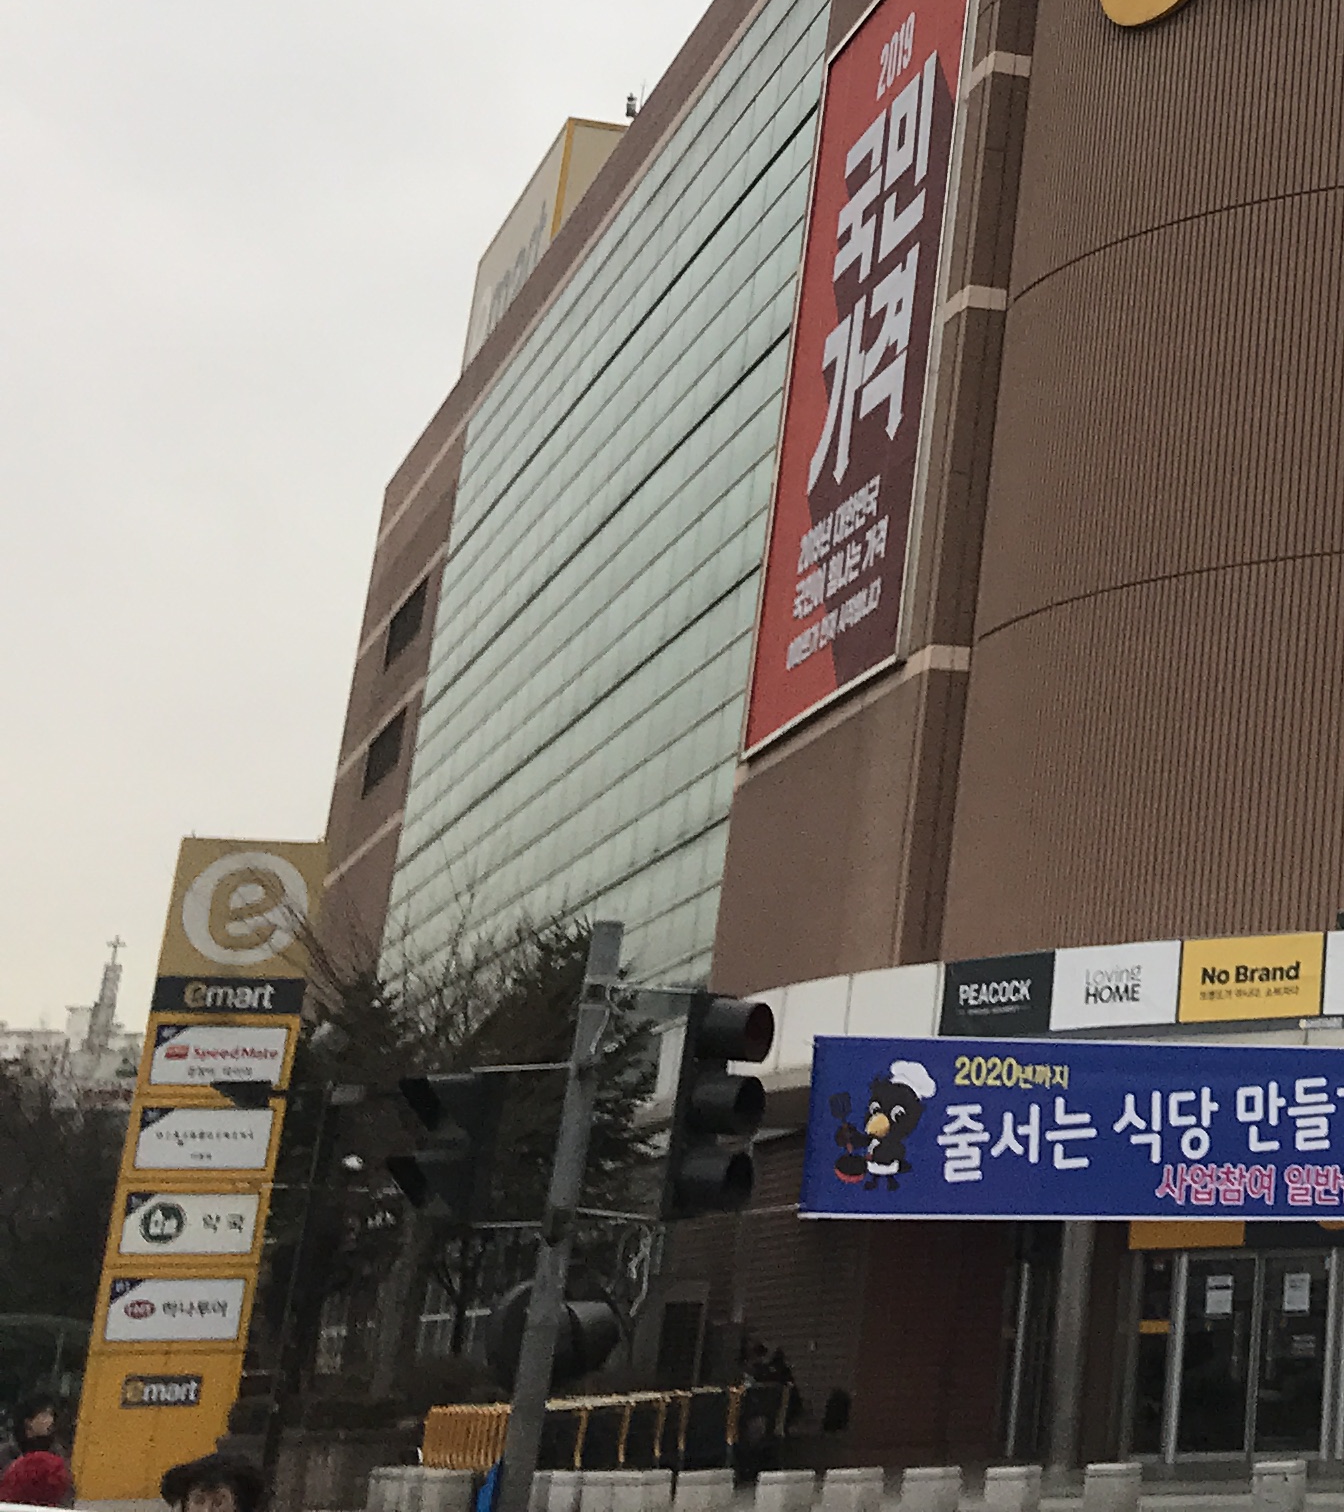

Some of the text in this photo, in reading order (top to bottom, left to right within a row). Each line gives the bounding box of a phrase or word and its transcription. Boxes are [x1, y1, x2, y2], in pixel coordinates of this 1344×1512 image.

[876, 11, 916, 101] 2019
[833, 49, 938, 284] 국민
[807, 241, 920, 496] 가격
[862, 514, 890, 572] 가격
[958, 978, 1032, 1006] PEACOCK
[1201, 960, 1301, 985] No Brand
[183, 981, 277, 1010] emart
[1084, 983, 1141, 1005] HOME
[953, 1055, 1070, 1091] 2020년까지
[937, 1096, 1097, 1184] 줄서는
[1112, 1086, 1220, 1165] 식당
[1155, 1162, 1277, 1207] 사업참여
[123, 1379, 199, 1404] emart
